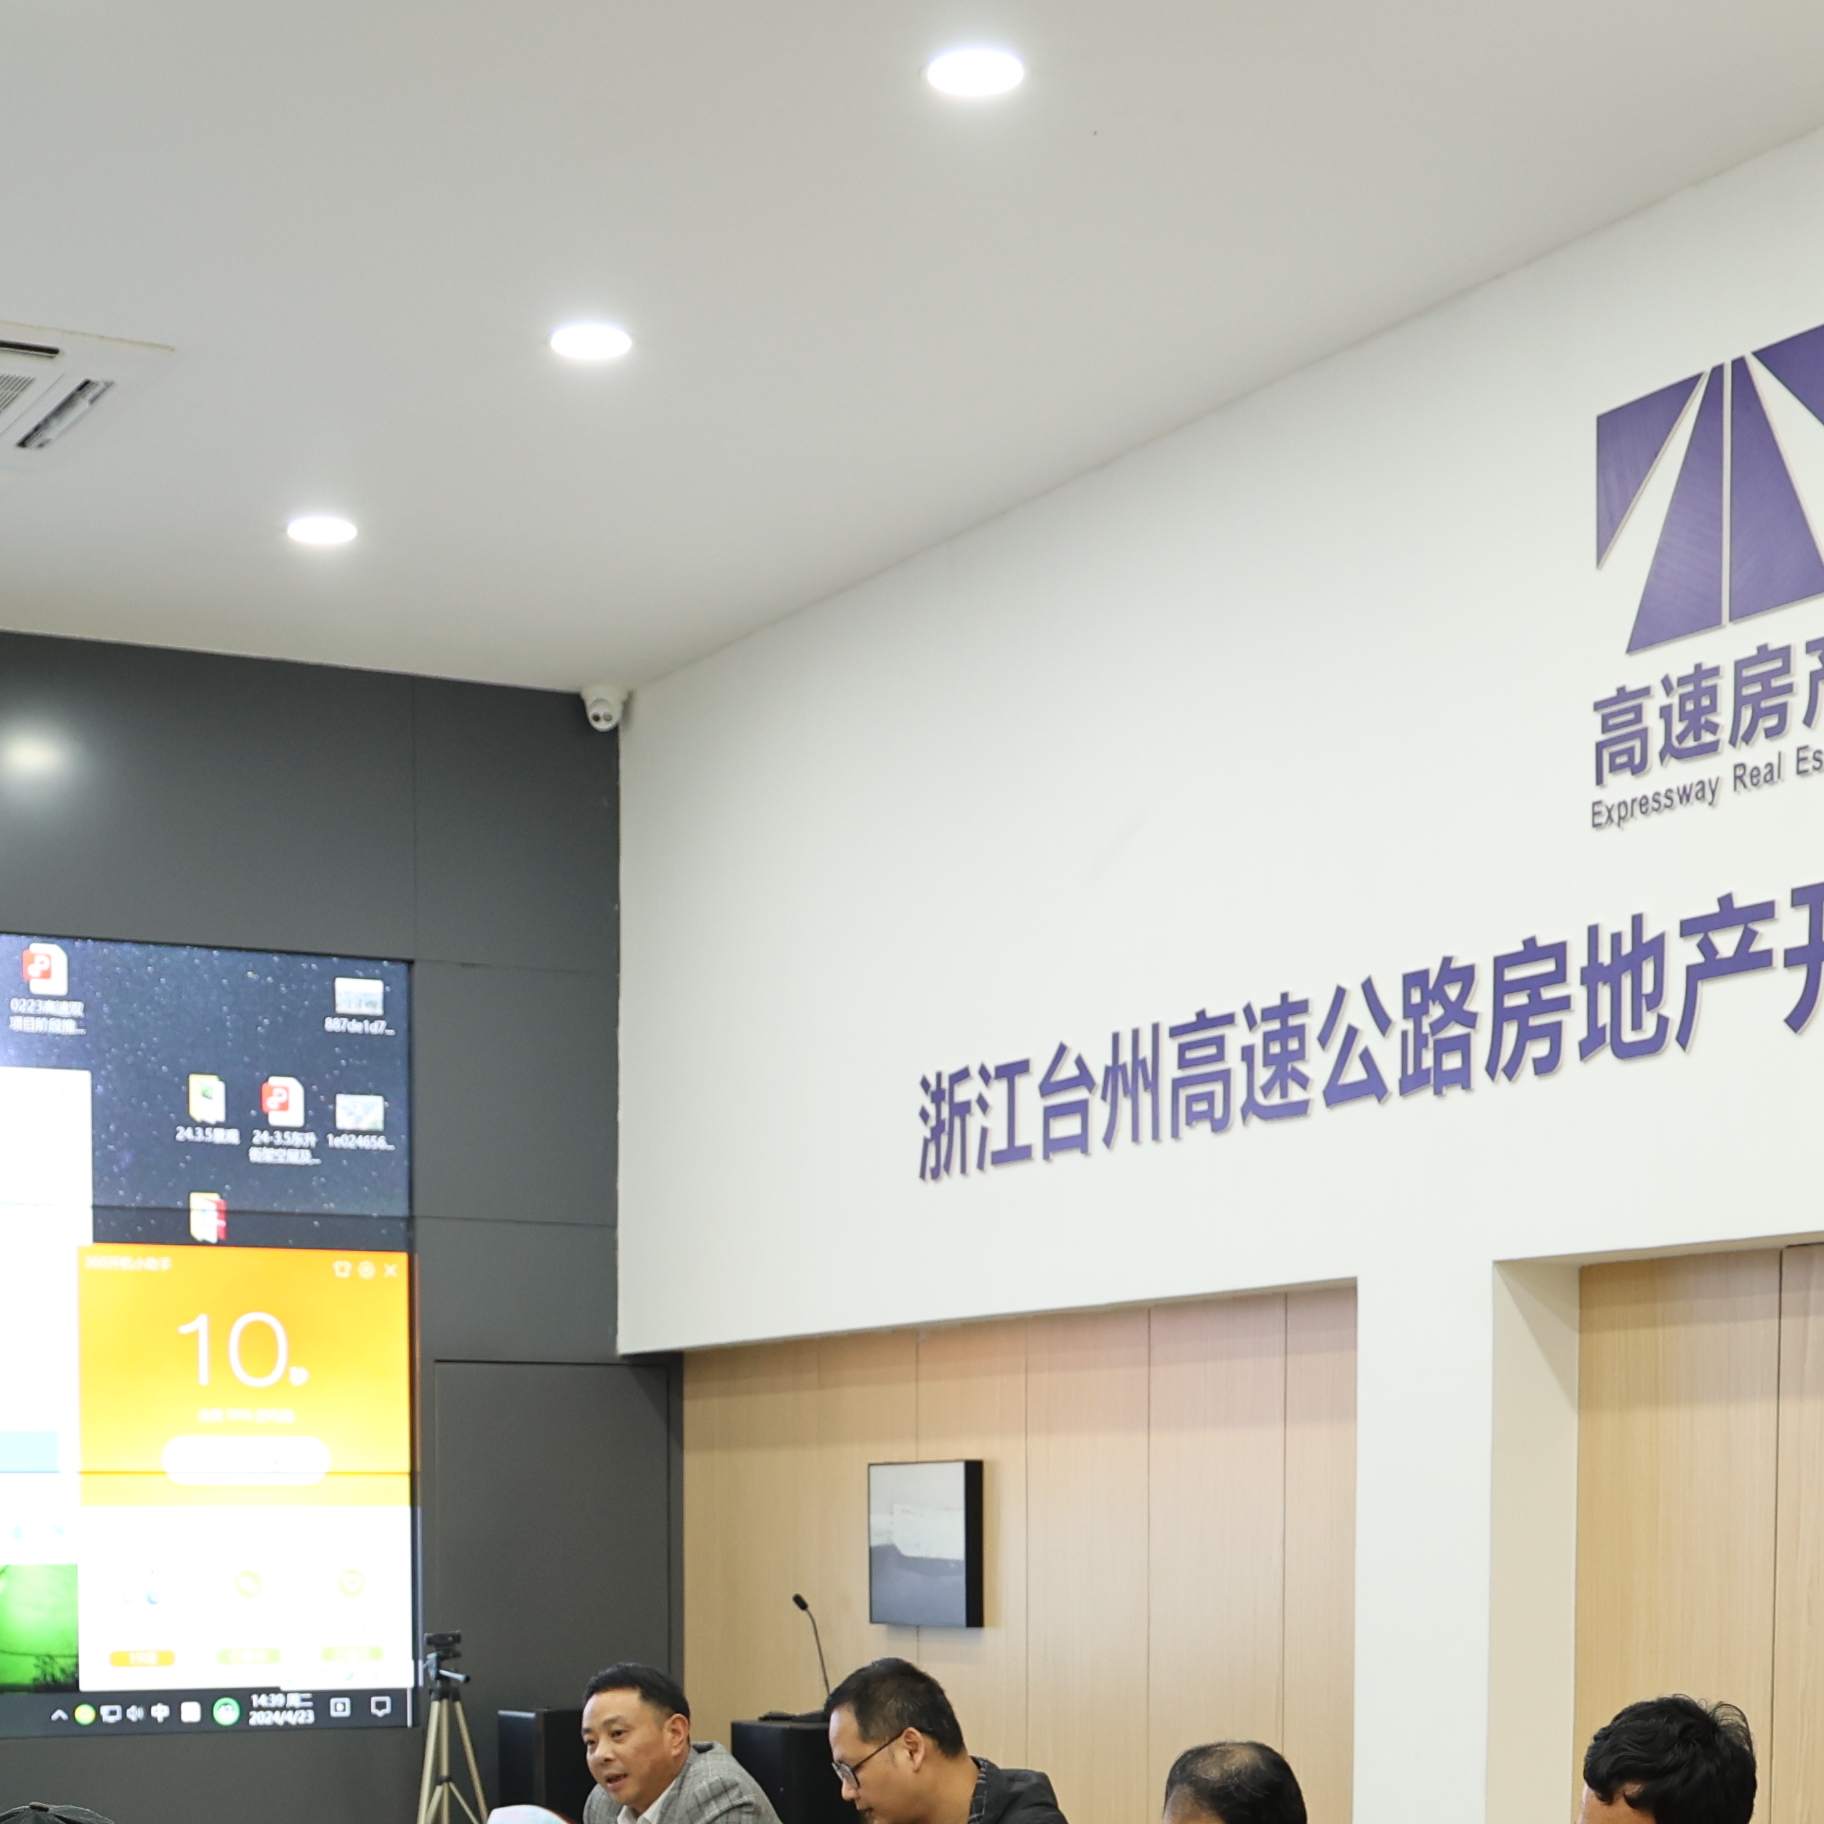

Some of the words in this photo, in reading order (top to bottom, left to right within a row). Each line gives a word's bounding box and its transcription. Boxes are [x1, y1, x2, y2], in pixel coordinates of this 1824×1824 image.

[1590, 773, 1722, 832] Expressway
[1731, 750, 1784, 794] Real
[177, 1311, 289, 1388] 10
[250, 1693, 285, 1708] 14:39
[286, 1692, 315, 1708] 周二
[150, 1703, 170, 1723] 中
[248, 1709, 315, 1726] 2024/4/23
